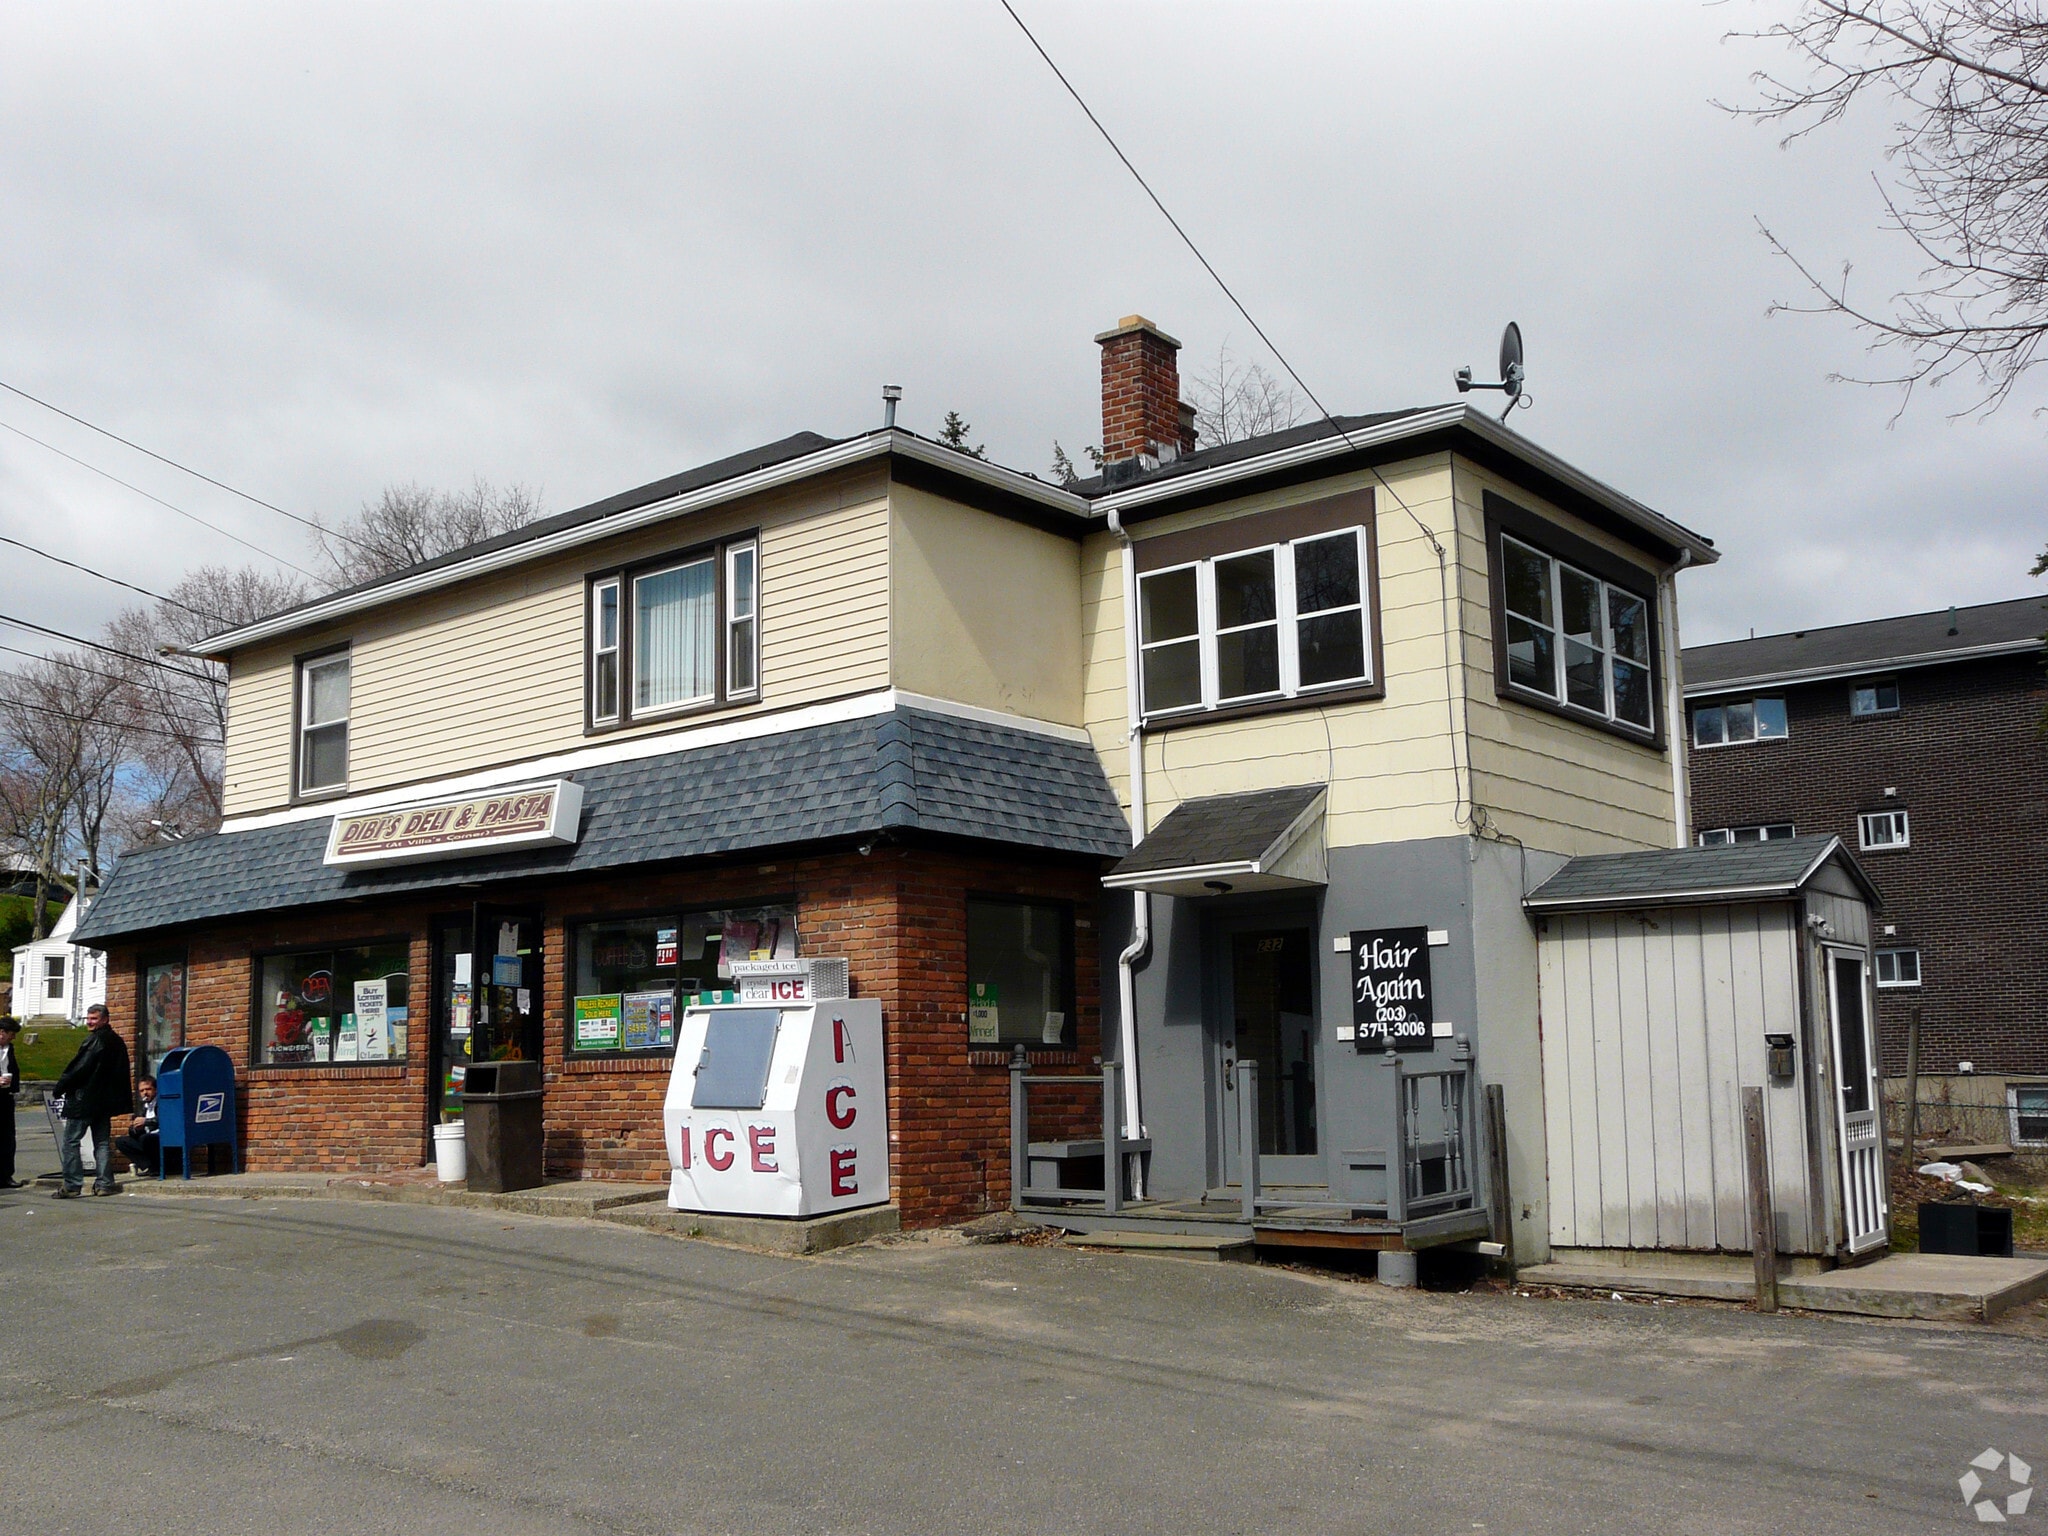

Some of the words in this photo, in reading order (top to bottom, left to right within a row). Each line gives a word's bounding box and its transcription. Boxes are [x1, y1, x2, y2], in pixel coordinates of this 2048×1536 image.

[340, 815, 402, 844] DIBI'S
[403, 806, 455, 836] DELI
[455, 805, 477, 830] &
[478, 792, 554, 827] PASTA
[408, 836, 441, 846] Villa's
[1359, 938, 1418, 970] Hair
[734, 963, 780, 973] packaged
[782, 962, 797, 970] ice
[745, 987, 770, 1000] clear
[771, 979, 805, 1000] ICE
[1357, 972, 1425, 1008] Again
[1376, 1005, 1407, 1022] (203)
[1359, 1021, 1426, 1038] 574-3006
[826, 1012, 858, 1198] ICE
[680, 1119, 779, 1173] ICE
